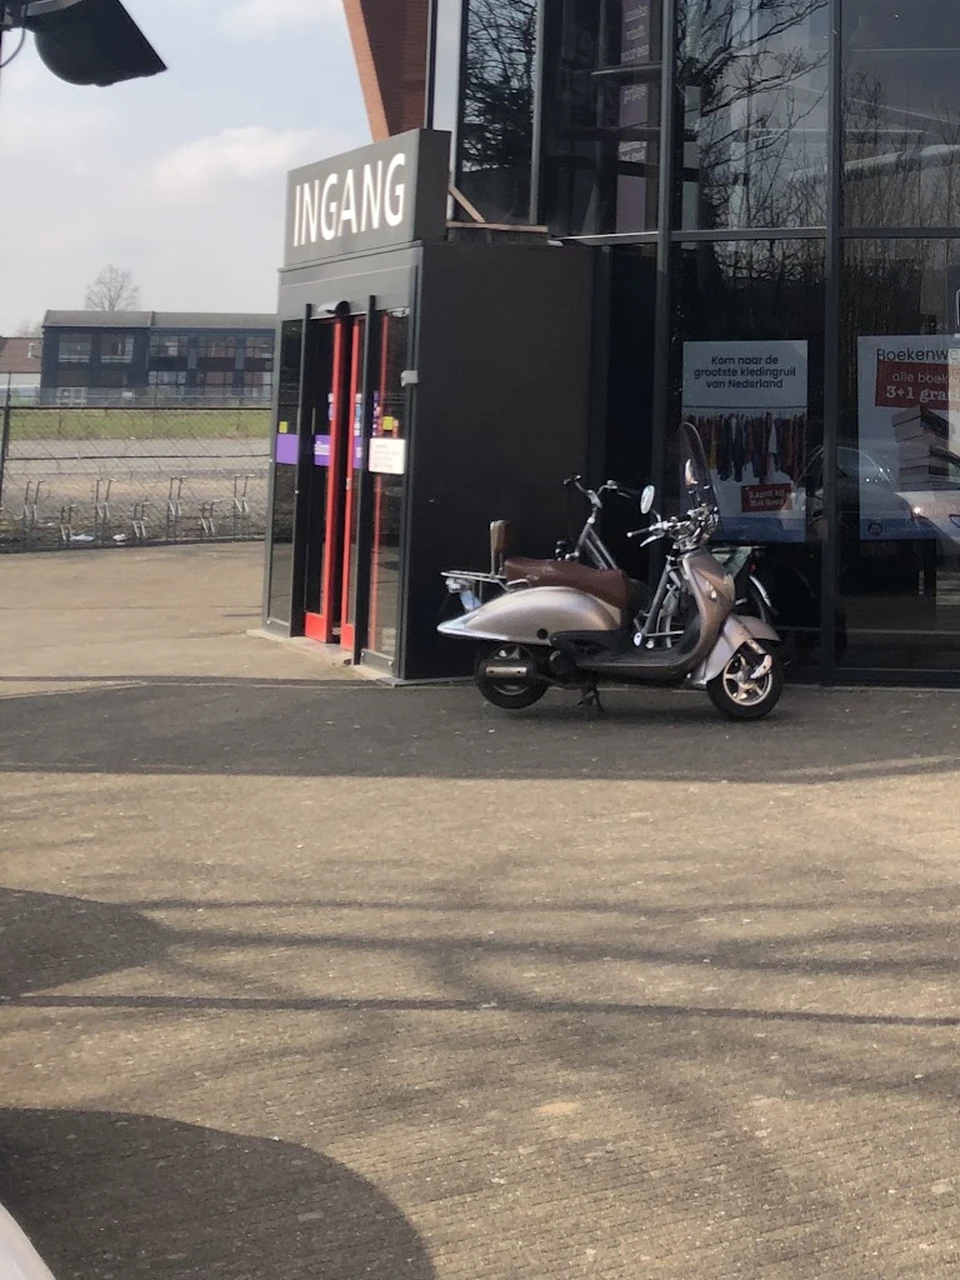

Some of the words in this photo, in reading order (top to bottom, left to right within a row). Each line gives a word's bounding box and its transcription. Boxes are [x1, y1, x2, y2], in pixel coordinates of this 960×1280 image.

[293, 152, 406, 247] INGANG
[711, 356, 736, 365] Kom
[737, 357, 763, 365] naar
[764, 355, 779, 365] de
[693, 368, 738, 380] grootste
[740, 366, 797, 379] kledingruil
[891, 371, 915, 383] alle
[706, 380, 726, 389] van
[727, 379, 784, 389] Nederland
[886, 386, 915, 400] 3+1
